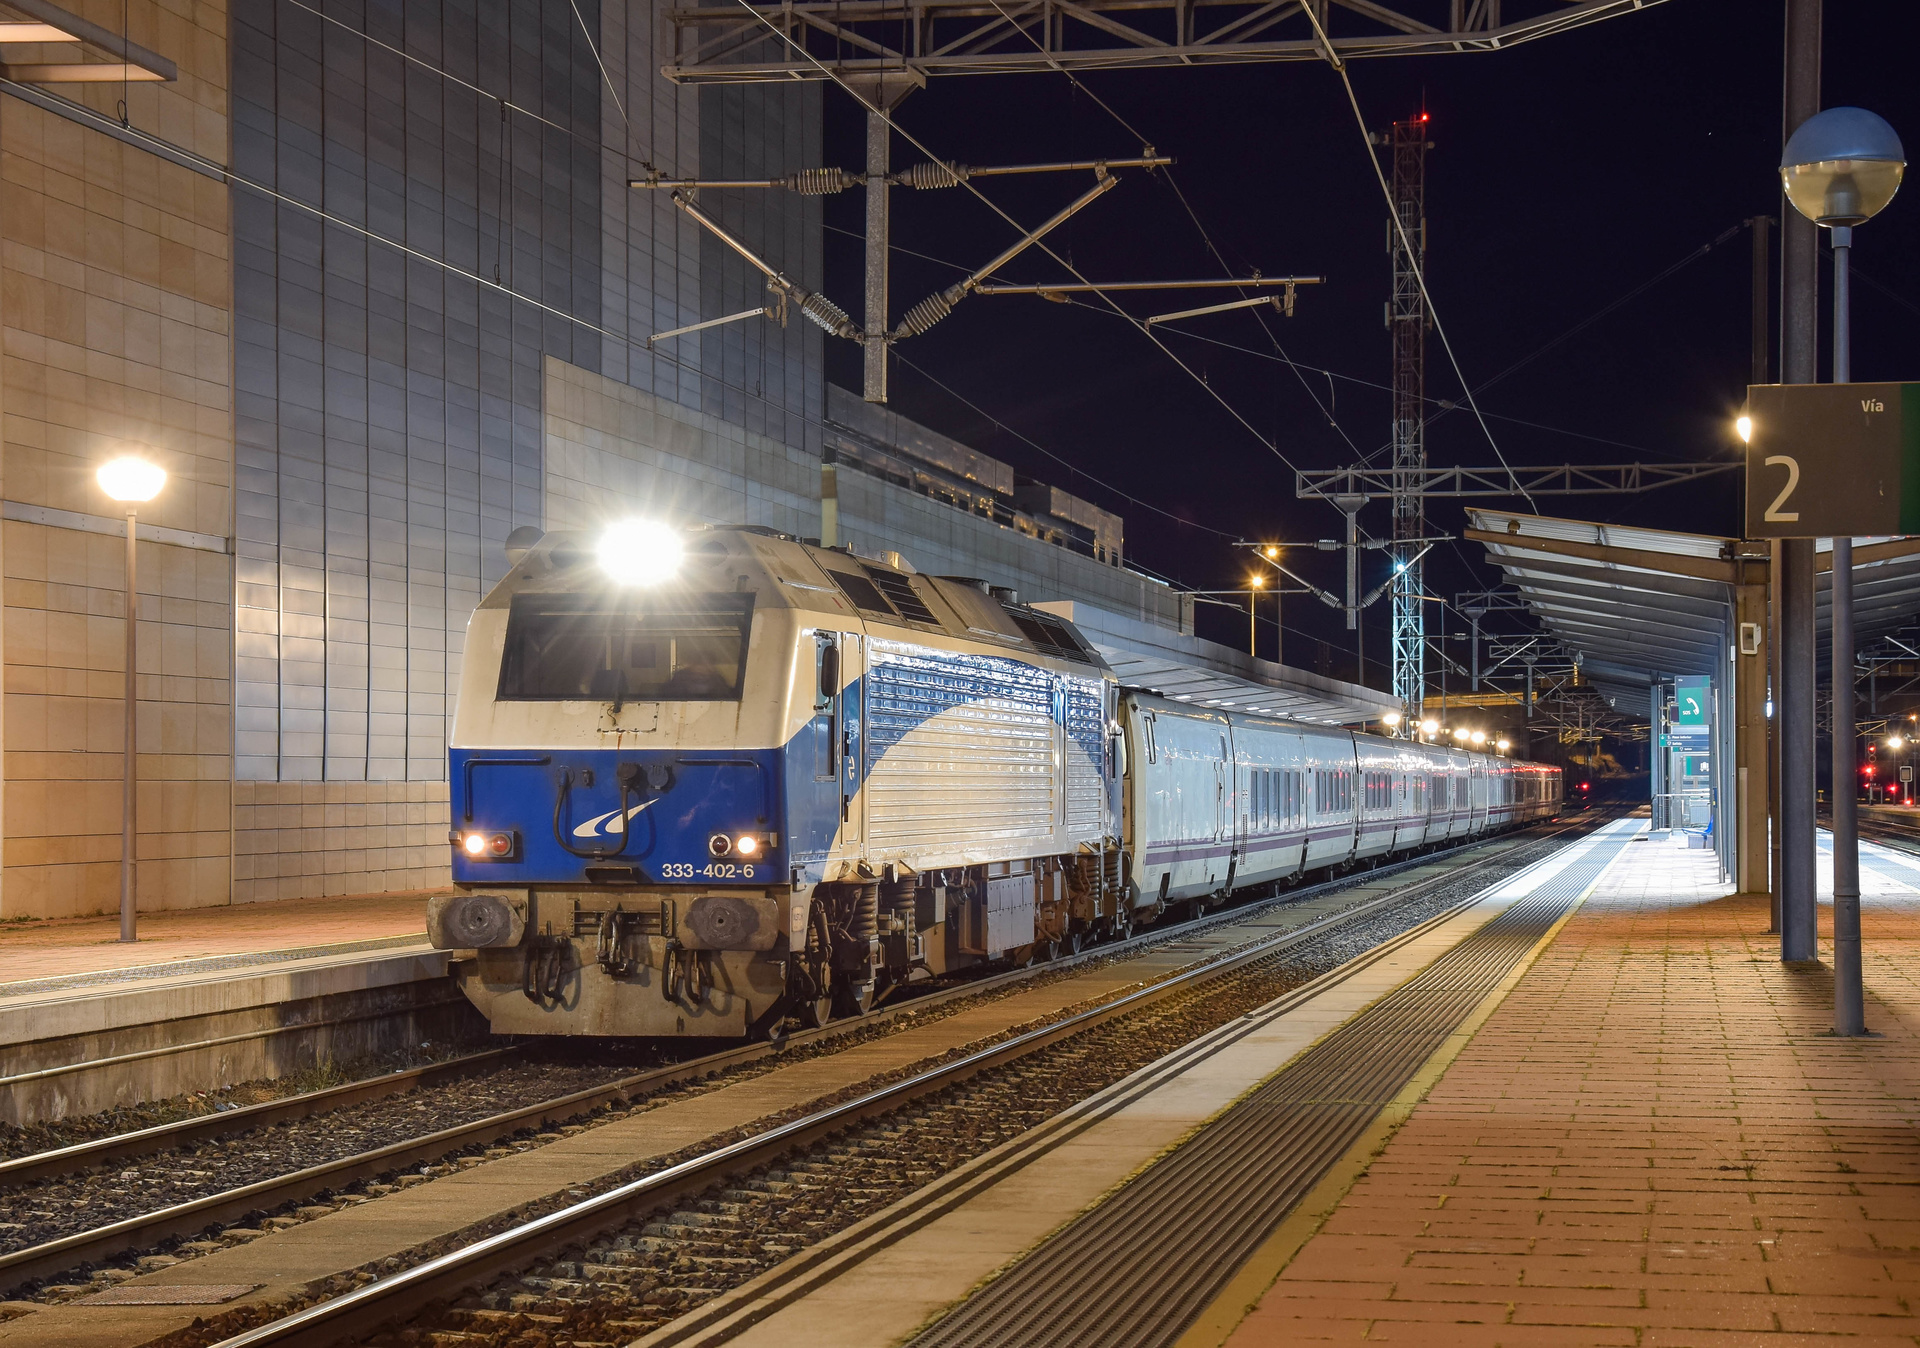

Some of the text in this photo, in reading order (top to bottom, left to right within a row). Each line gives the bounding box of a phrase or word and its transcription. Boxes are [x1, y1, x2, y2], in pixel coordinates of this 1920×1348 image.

[1861, 399, 1884, 412] Vía
[1764, 455, 1799, 522] 2
[662, 863, 754, 878] 333-402-6
